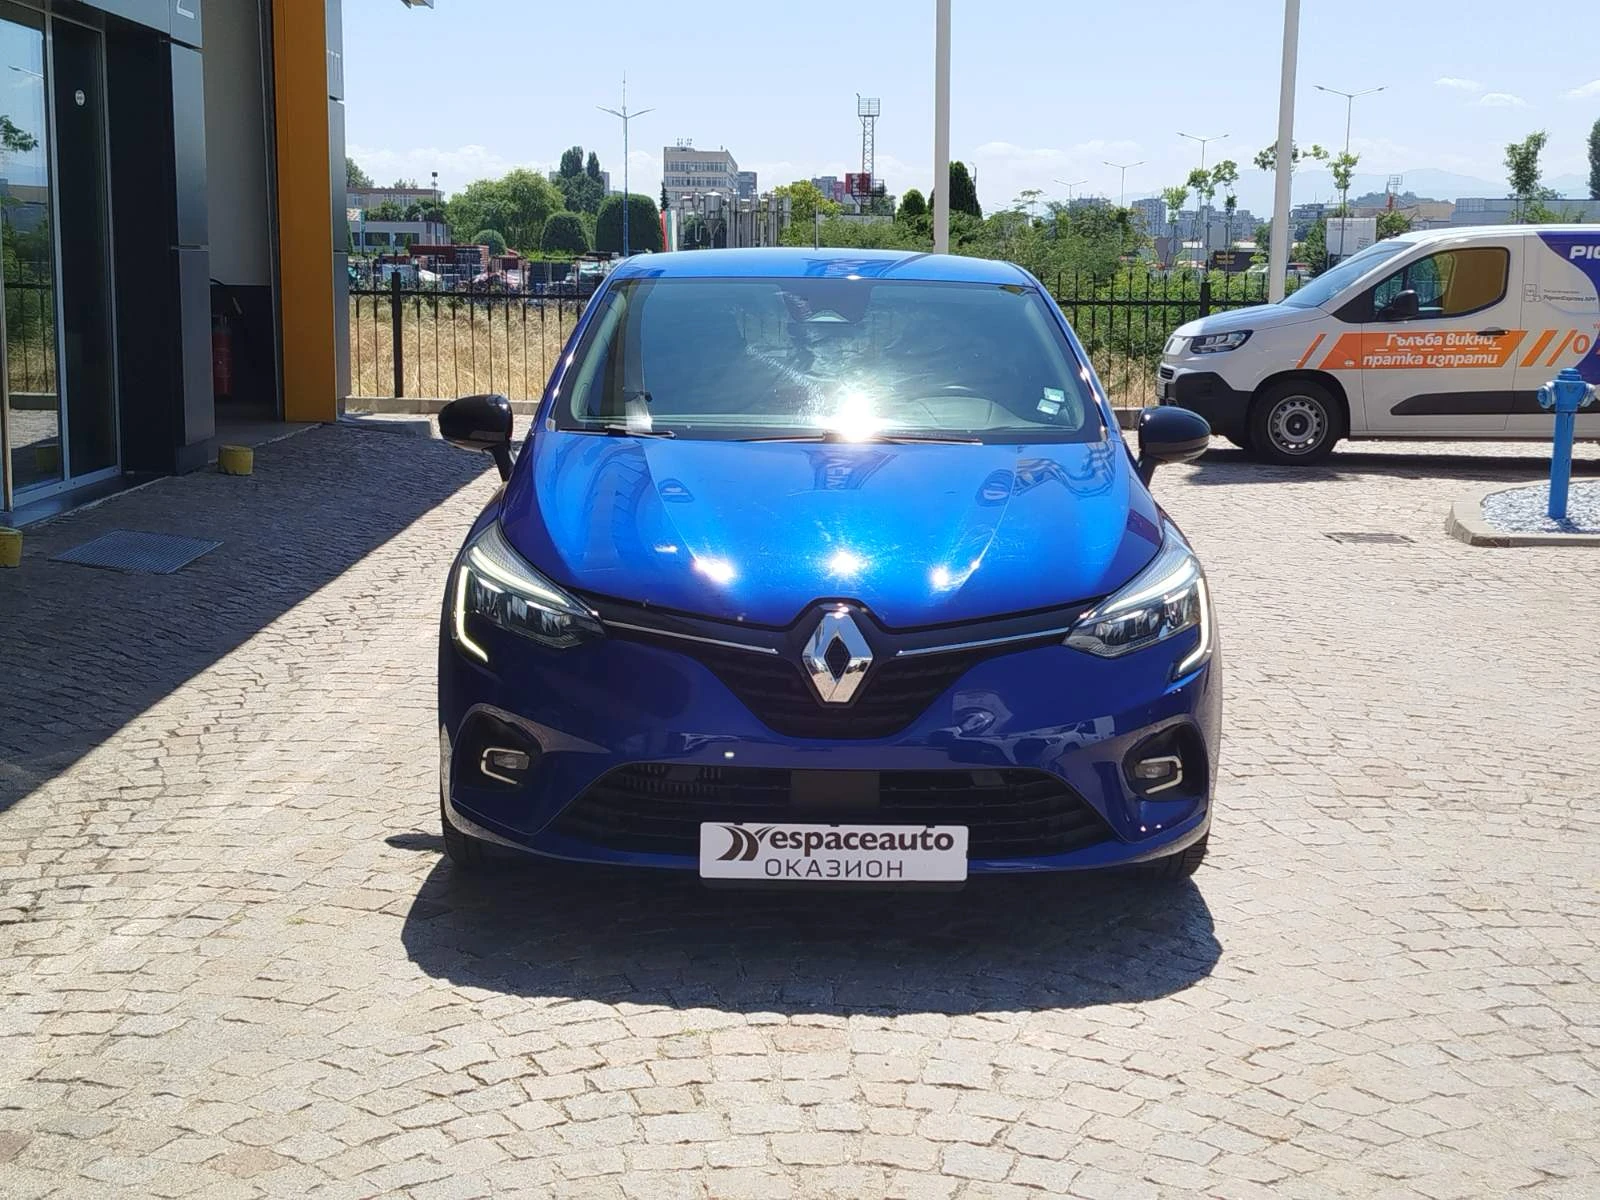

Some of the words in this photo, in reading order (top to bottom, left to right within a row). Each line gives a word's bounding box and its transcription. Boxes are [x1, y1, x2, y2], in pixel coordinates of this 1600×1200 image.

[1386, 333, 1443, 347] Гълъба
[1362, 353, 1424, 368] пратка
[1426, 352, 1498, 367] изпрати
[769, 828, 954, 857] espaceauto
[764, 858, 904, 878] ОКАЗИОН
